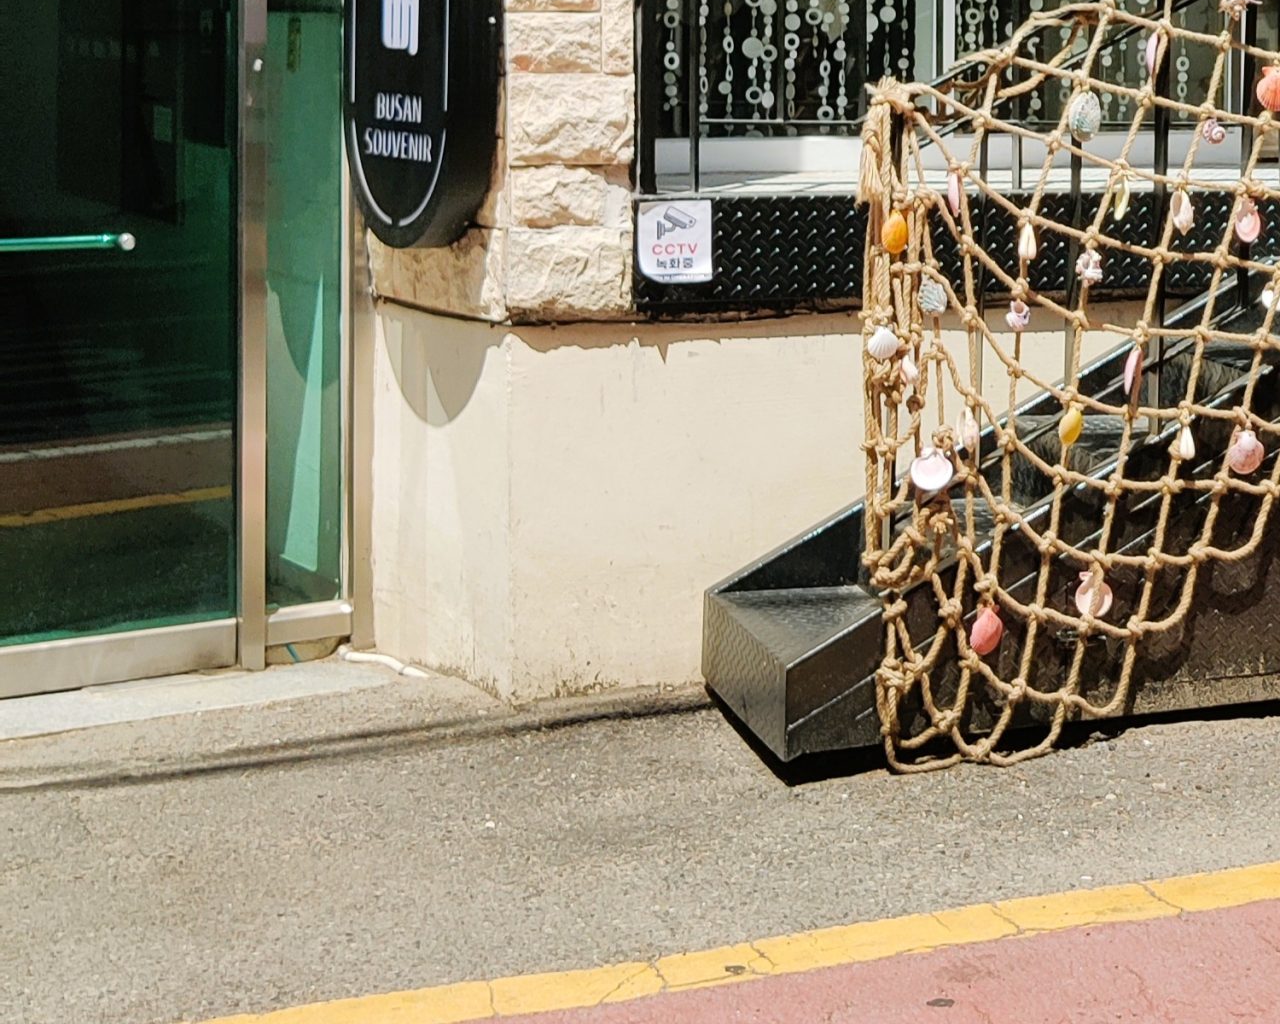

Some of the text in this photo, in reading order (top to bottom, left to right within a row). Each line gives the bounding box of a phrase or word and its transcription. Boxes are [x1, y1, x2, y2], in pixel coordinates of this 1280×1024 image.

[375, 91, 422, 124] BUSAN
[364, 127, 432, 163] SOUVENIR
[652, 242, 698, 256] CCTV
[656, 257, 694, 270] 녹화중
